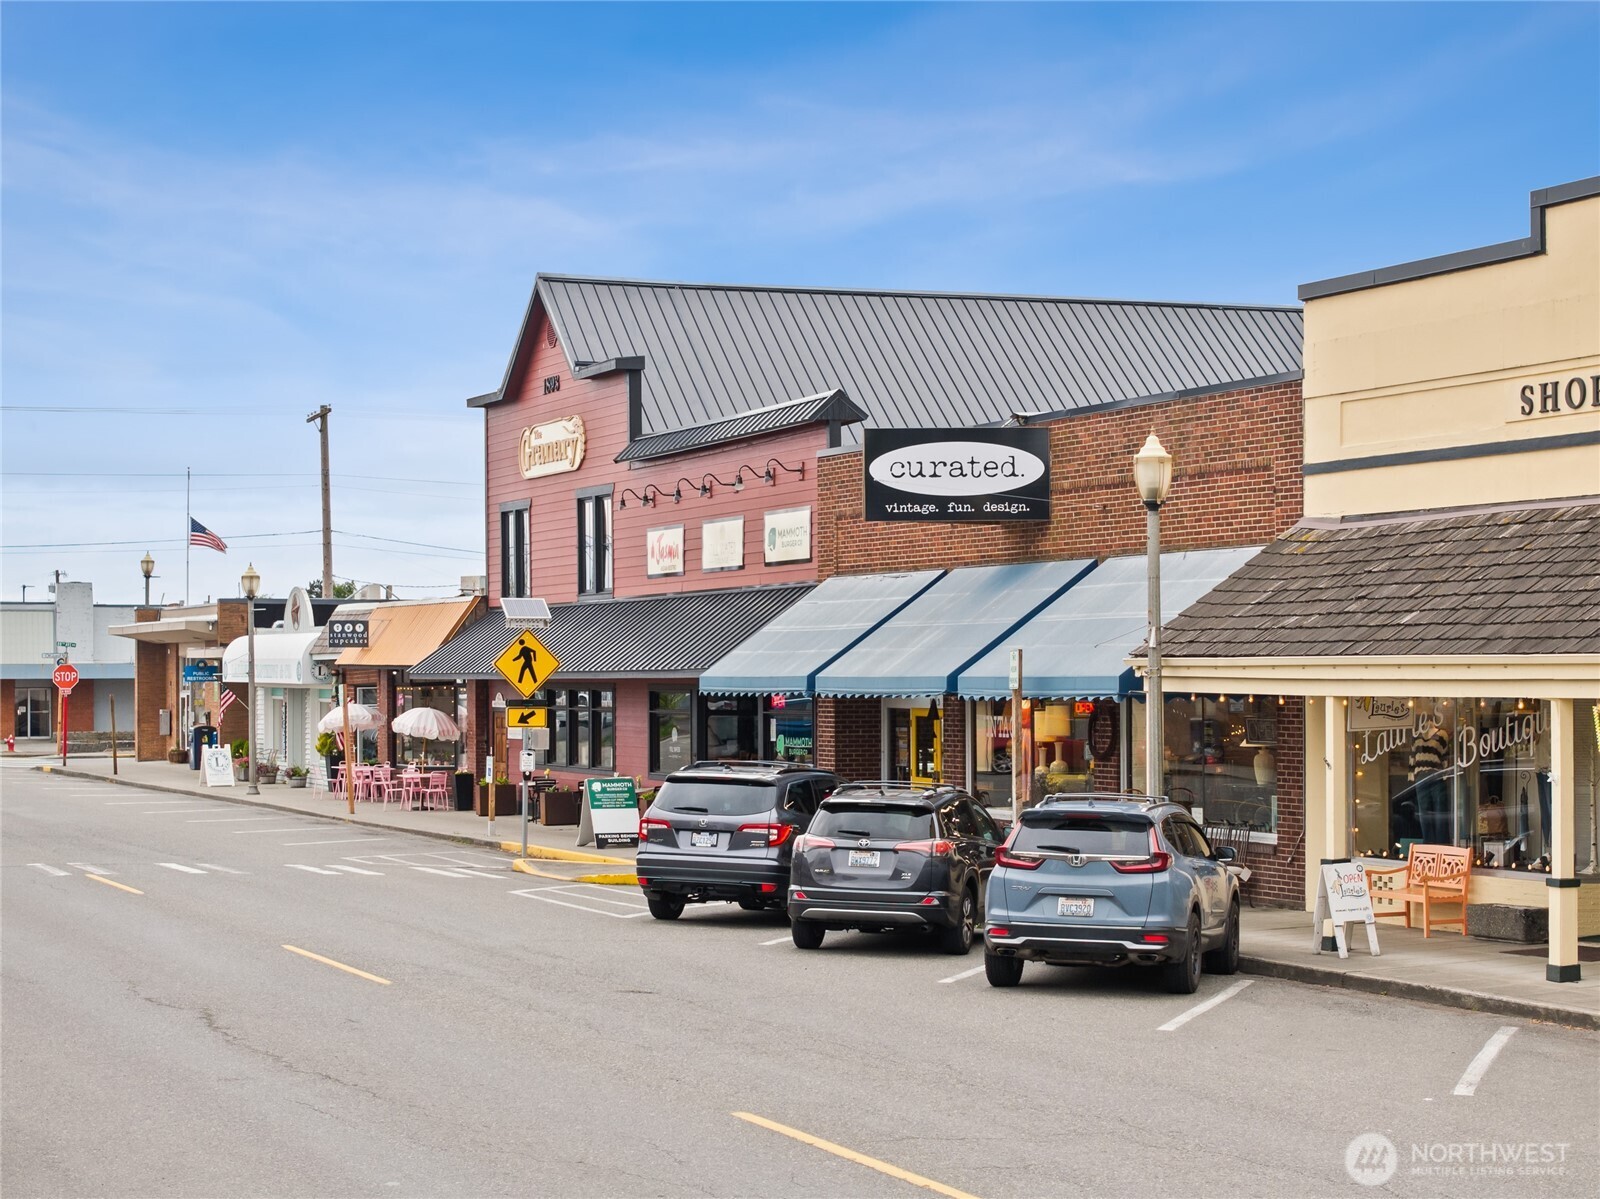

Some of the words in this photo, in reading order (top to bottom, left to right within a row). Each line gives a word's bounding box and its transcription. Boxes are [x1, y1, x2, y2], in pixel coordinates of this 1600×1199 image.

[523, 437, 580, 472] Granary
[889, 455, 1025, 479] curated.
[885, 502, 939, 514] vintage.
[947, 502, 975, 513] fun.
[983, 502, 1030, 514] design.
[778, 525, 808, 539] MAMMOTH
[330, 637, 368, 645] cupcakes
[55, 671, 77, 682] STOP
[785, 737, 812, 747] MAMMOTH
[1343, 873, 1363, 884] OPEN
